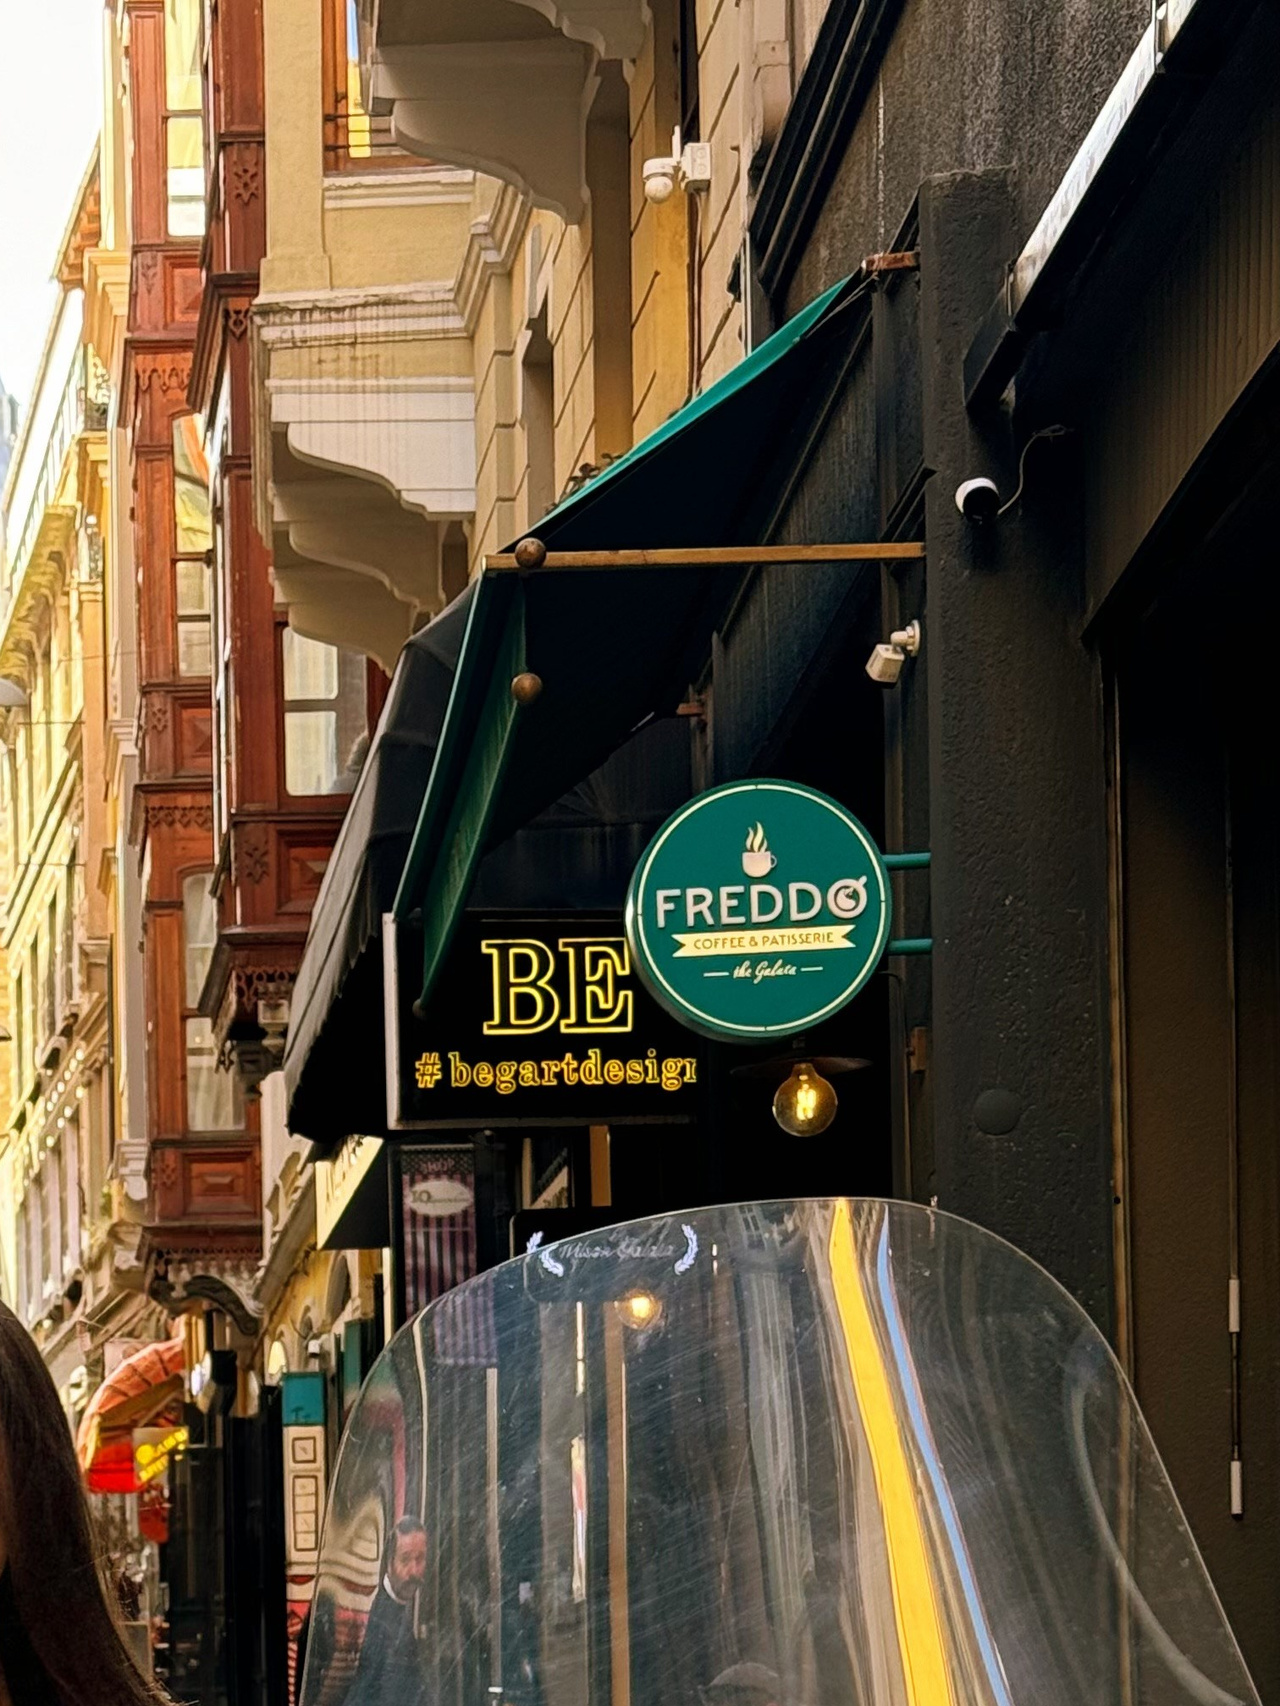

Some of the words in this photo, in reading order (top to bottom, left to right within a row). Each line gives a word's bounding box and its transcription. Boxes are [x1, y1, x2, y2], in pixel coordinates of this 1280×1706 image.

[656, 875, 868, 929] FREDDO
[693, 936, 744, 950] COFFEE
[748, 935, 759, 946] &
[762, 932, 834, 946] PATISSERIE
[481, 937, 633, 1035] BE
[732, 960, 752, 979] the
[753, 958, 797, 984] Galata
